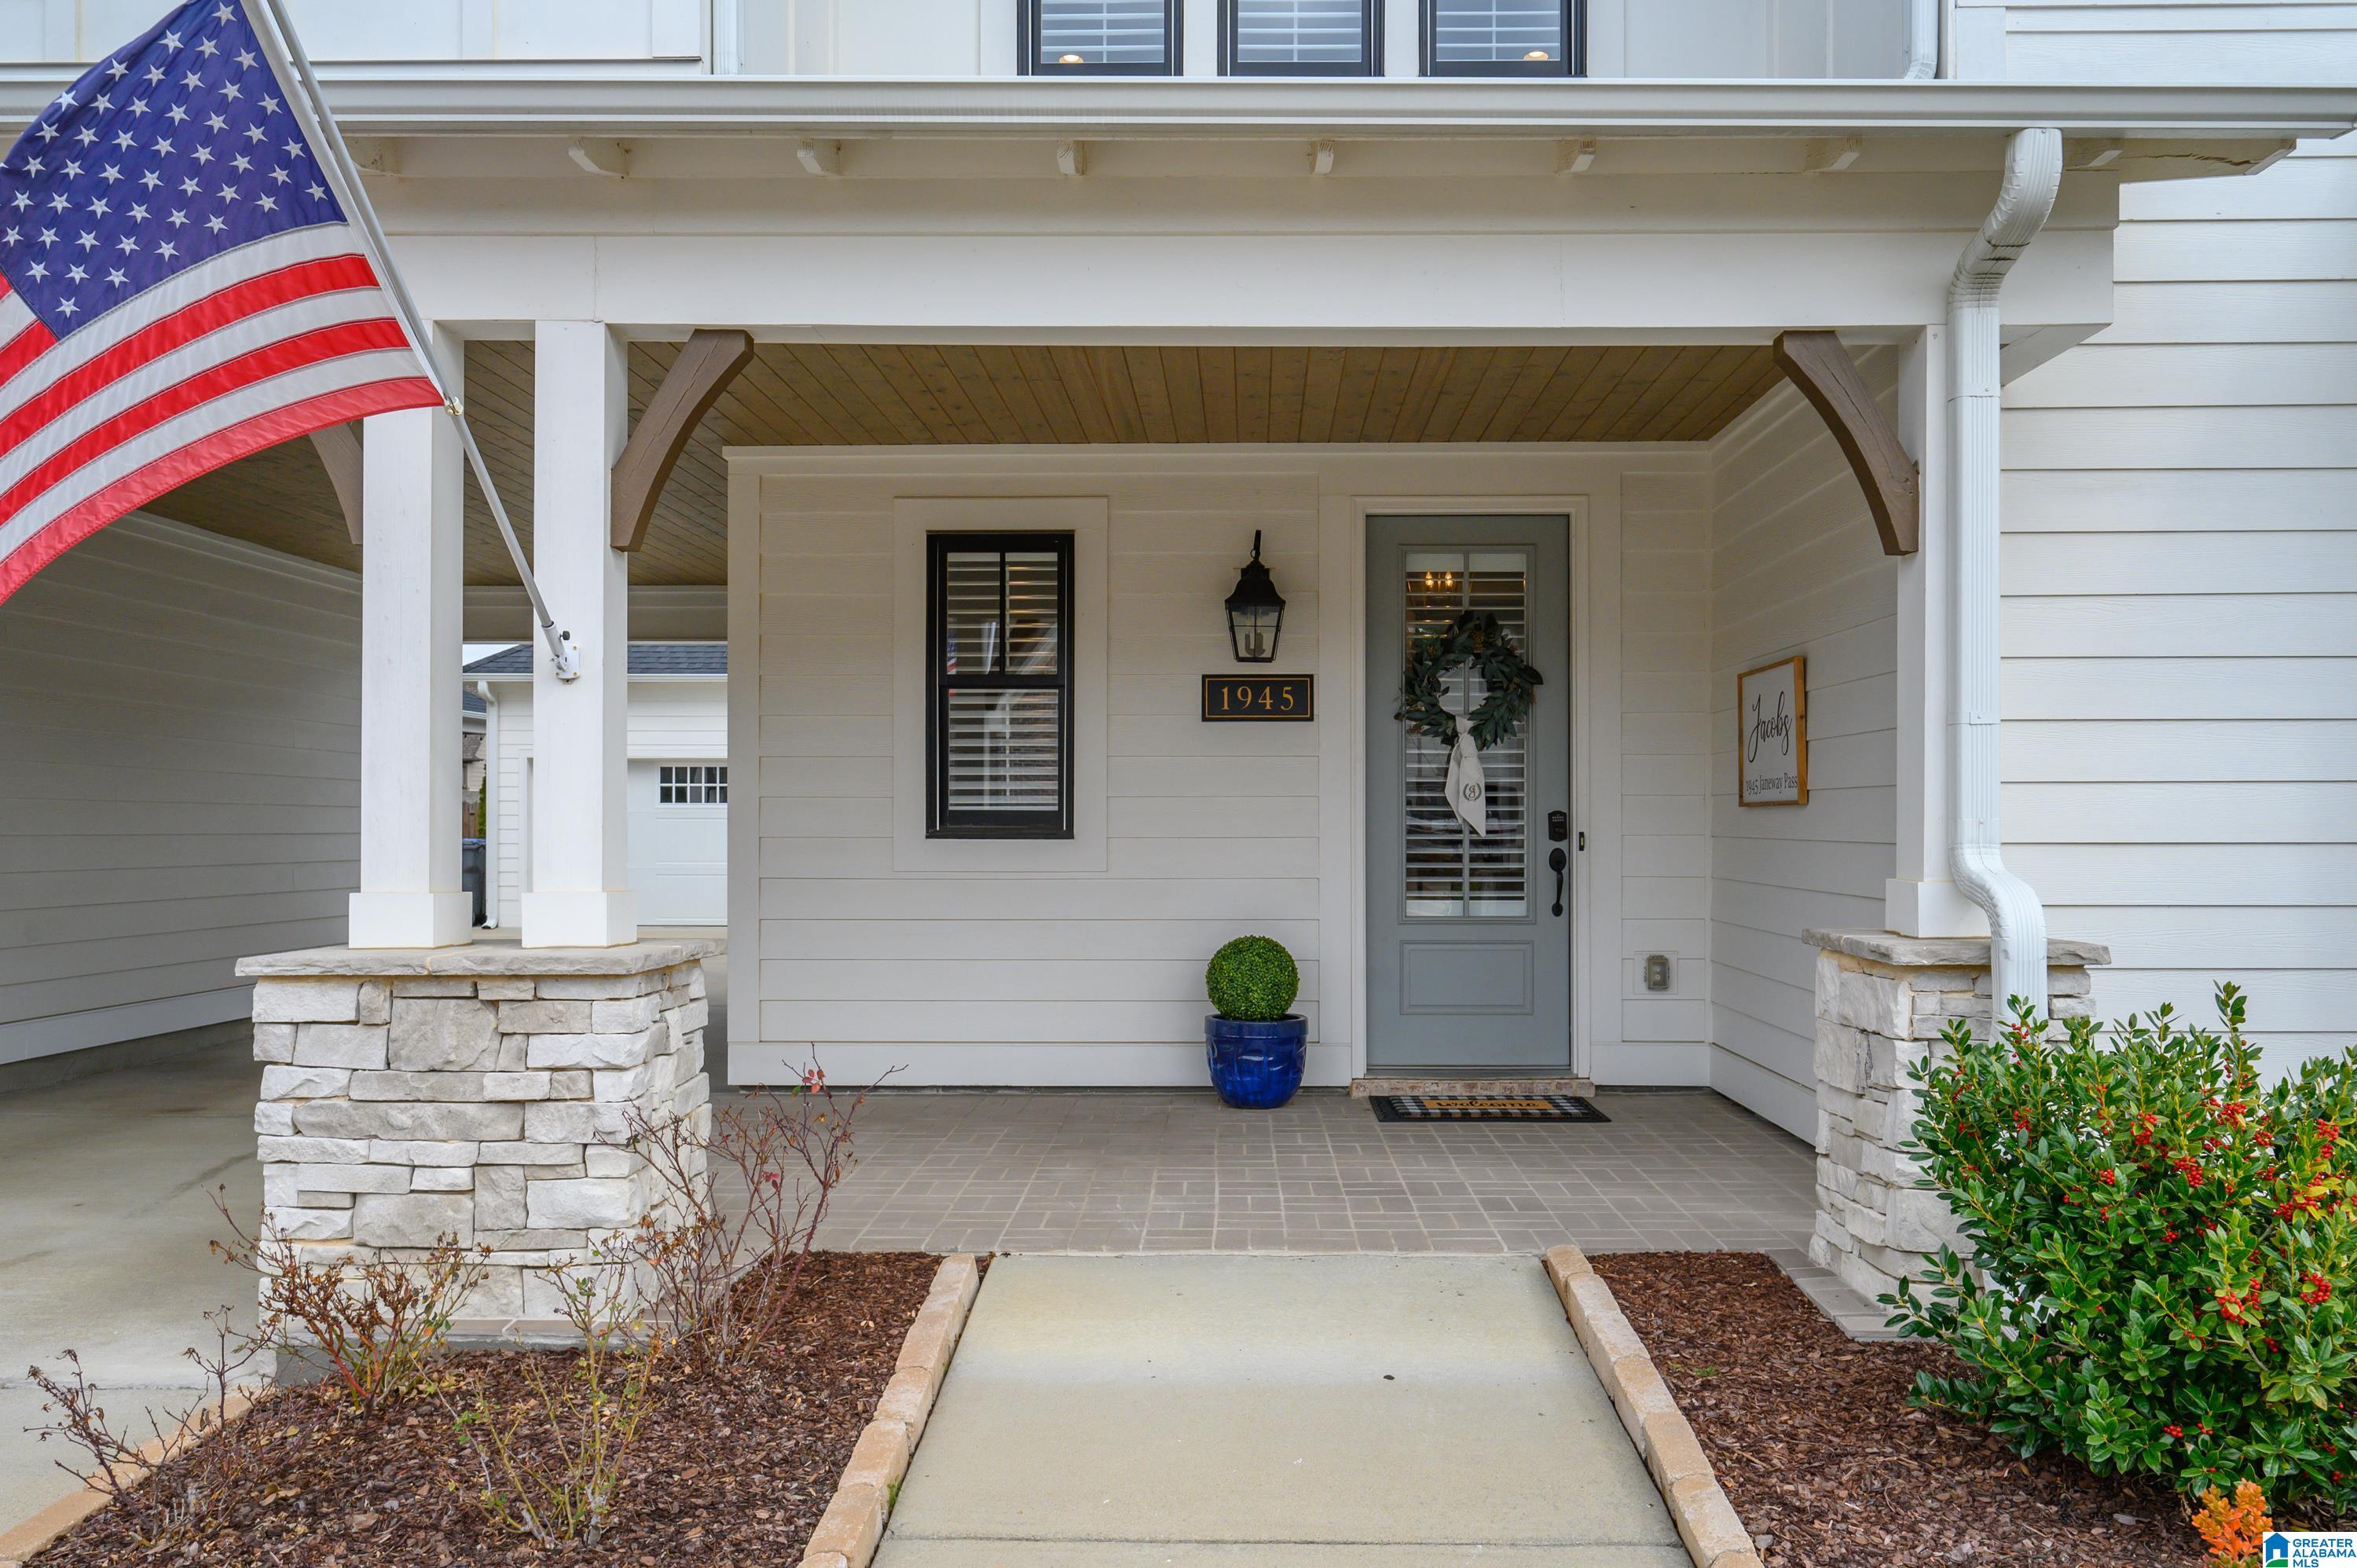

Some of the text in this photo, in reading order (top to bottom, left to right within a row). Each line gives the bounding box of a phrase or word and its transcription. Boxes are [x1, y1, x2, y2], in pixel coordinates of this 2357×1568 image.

[1221, 686, 1294, 711] 1945
[1747, 691, 1792, 763] Jacobs
[1746, 772, 1798, 795] 1945 Janeway Pass
